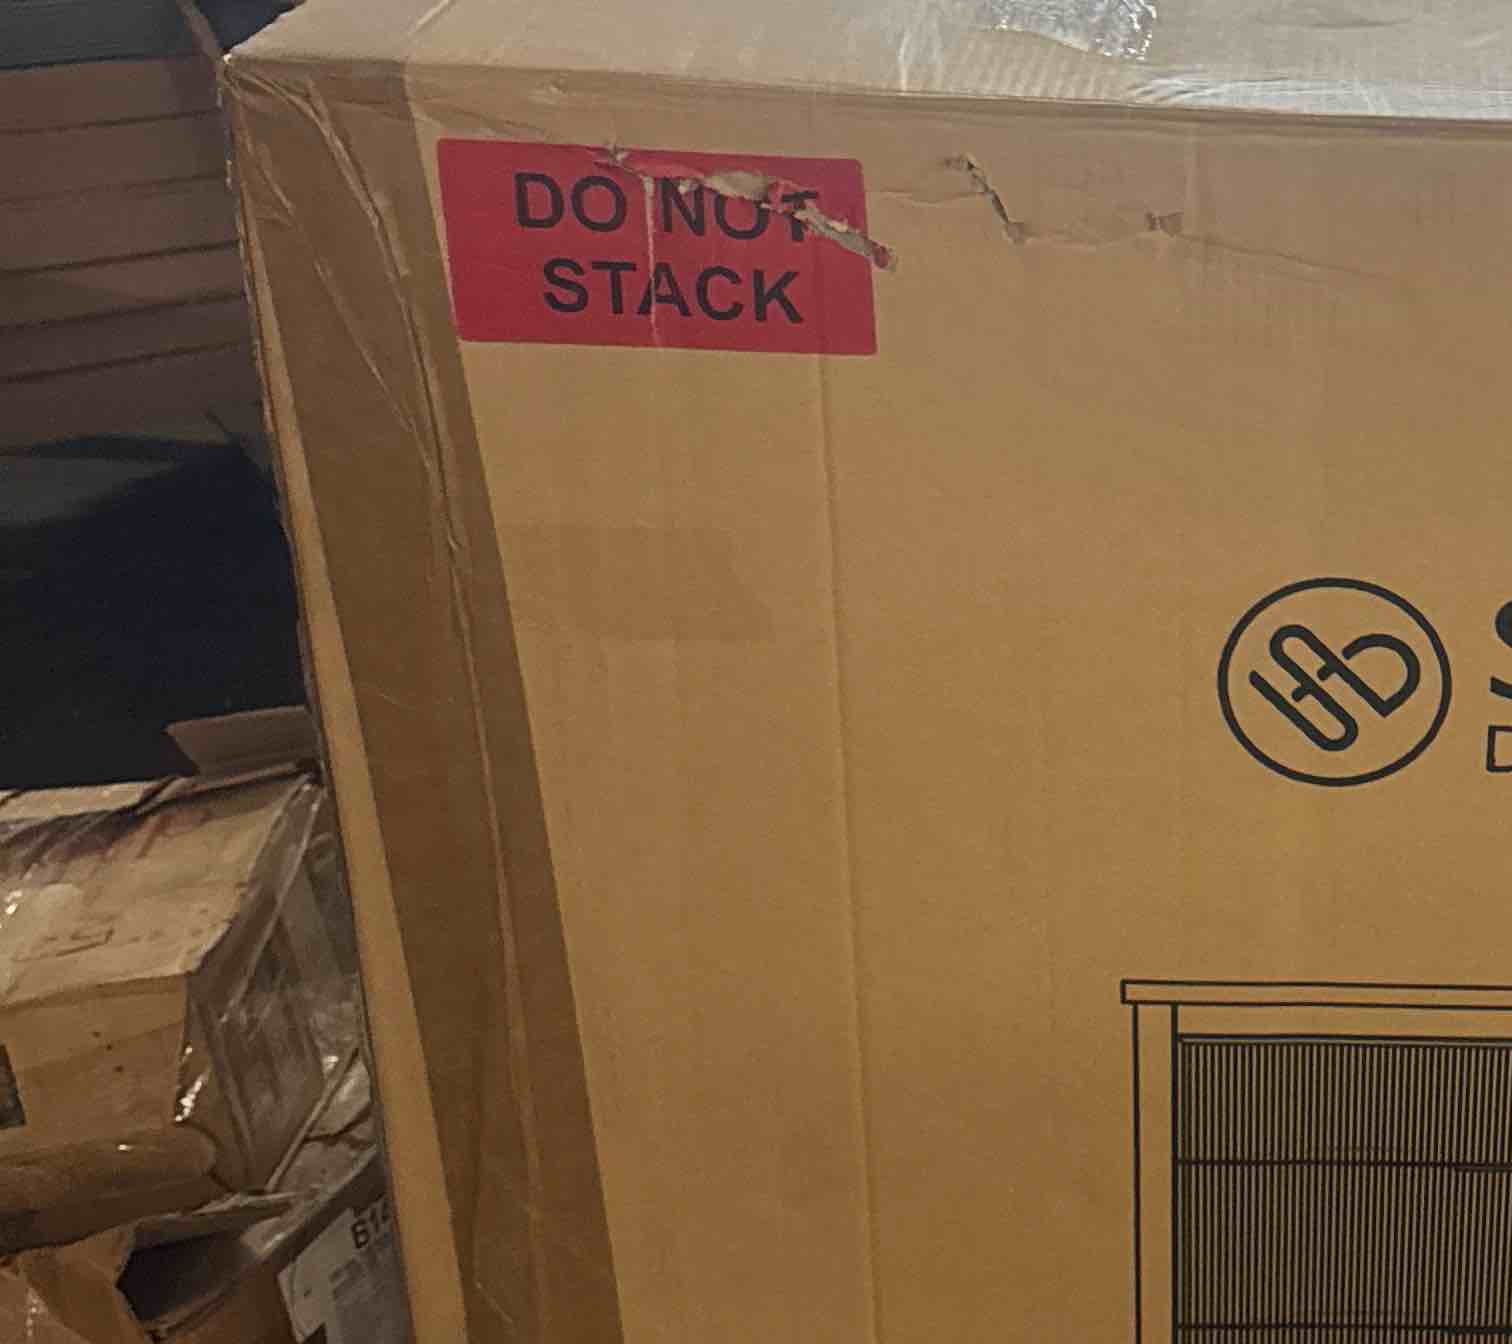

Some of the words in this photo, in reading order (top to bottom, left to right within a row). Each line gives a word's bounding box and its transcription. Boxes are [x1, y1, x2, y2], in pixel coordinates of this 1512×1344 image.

[513, 171, 629, 234] DO
[660, 174, 820, 244] NOT
[542, 257, 806, 325] STACK
